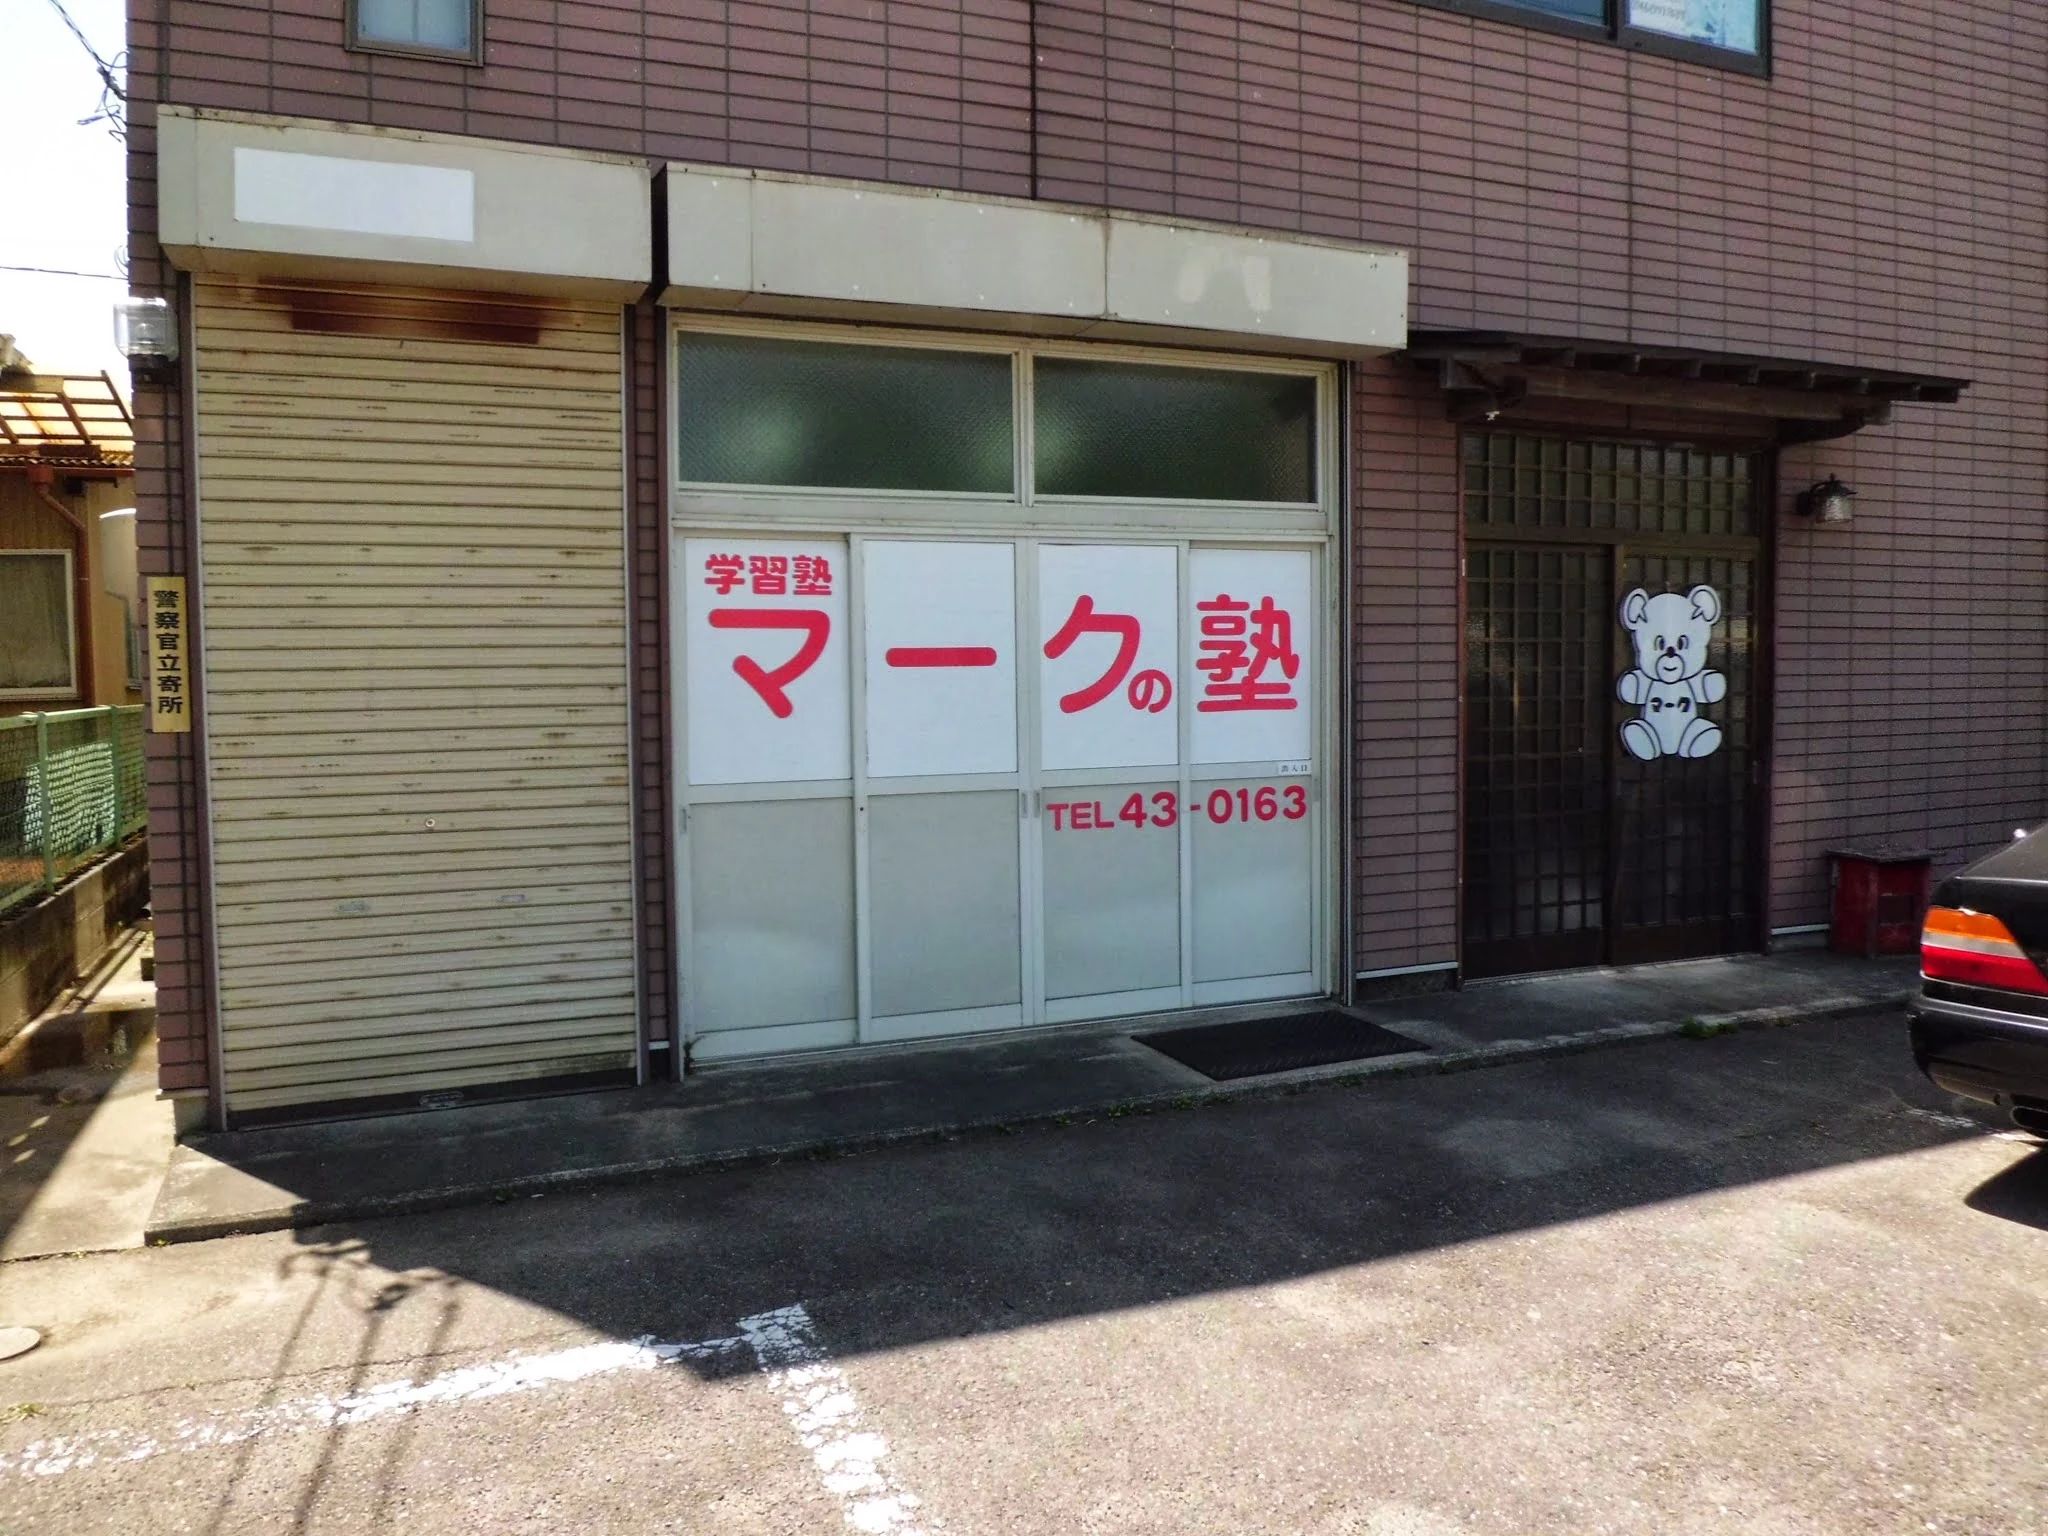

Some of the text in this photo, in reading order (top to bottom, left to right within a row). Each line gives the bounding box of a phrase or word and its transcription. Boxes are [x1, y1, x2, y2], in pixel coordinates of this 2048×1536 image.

[704, 554, 833, 597] 学習塾
[153, 590, 183, 714] 警察官立寄所
